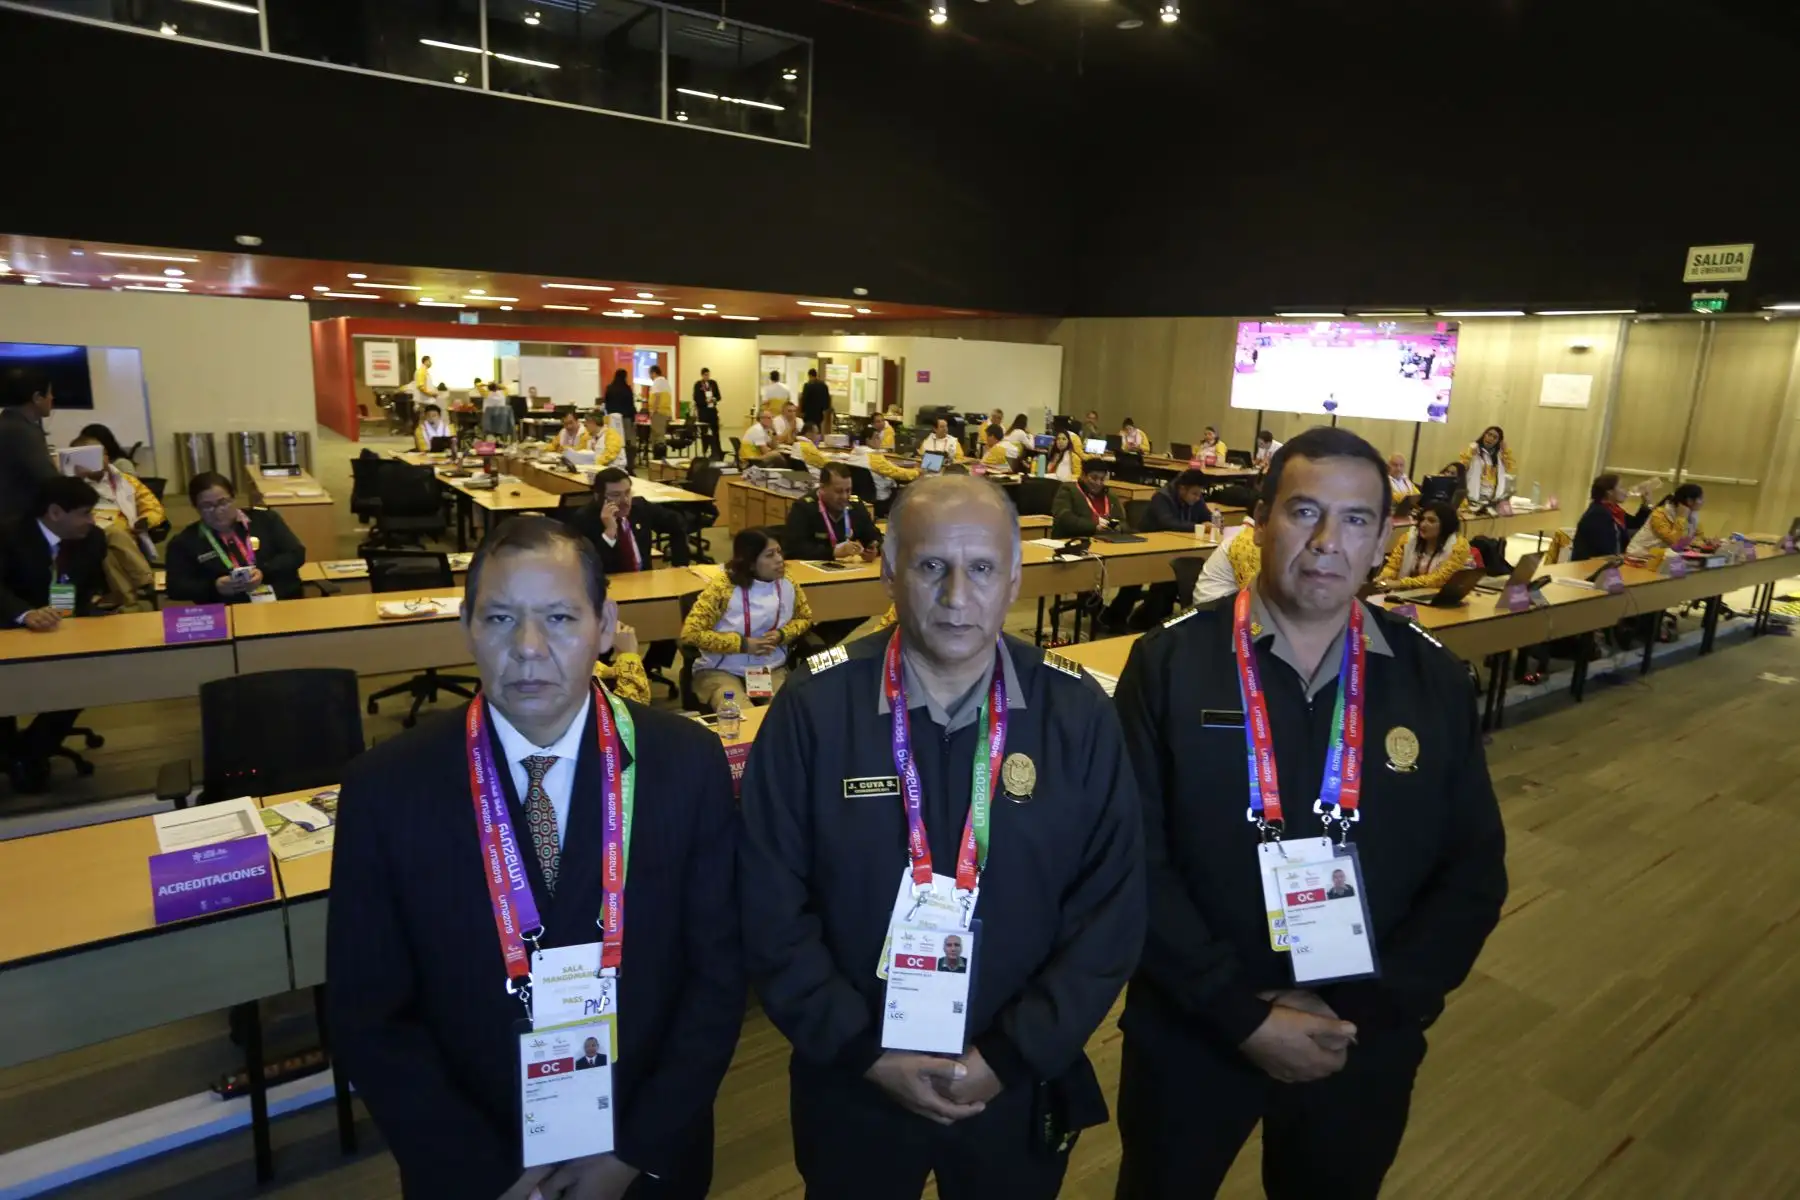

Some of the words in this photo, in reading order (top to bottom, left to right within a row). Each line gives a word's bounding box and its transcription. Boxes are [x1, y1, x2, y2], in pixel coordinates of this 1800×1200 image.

[1692, 252, 1744, 267] SALIDA
[158, 865, 267, 897] ACREDITACIONES
[1297, 892, 1315, 903] OC
[906, 957, 925, 968] OC
[562, 964, 584, 974] SALA
[540, 1061, 562, 1075] OC
